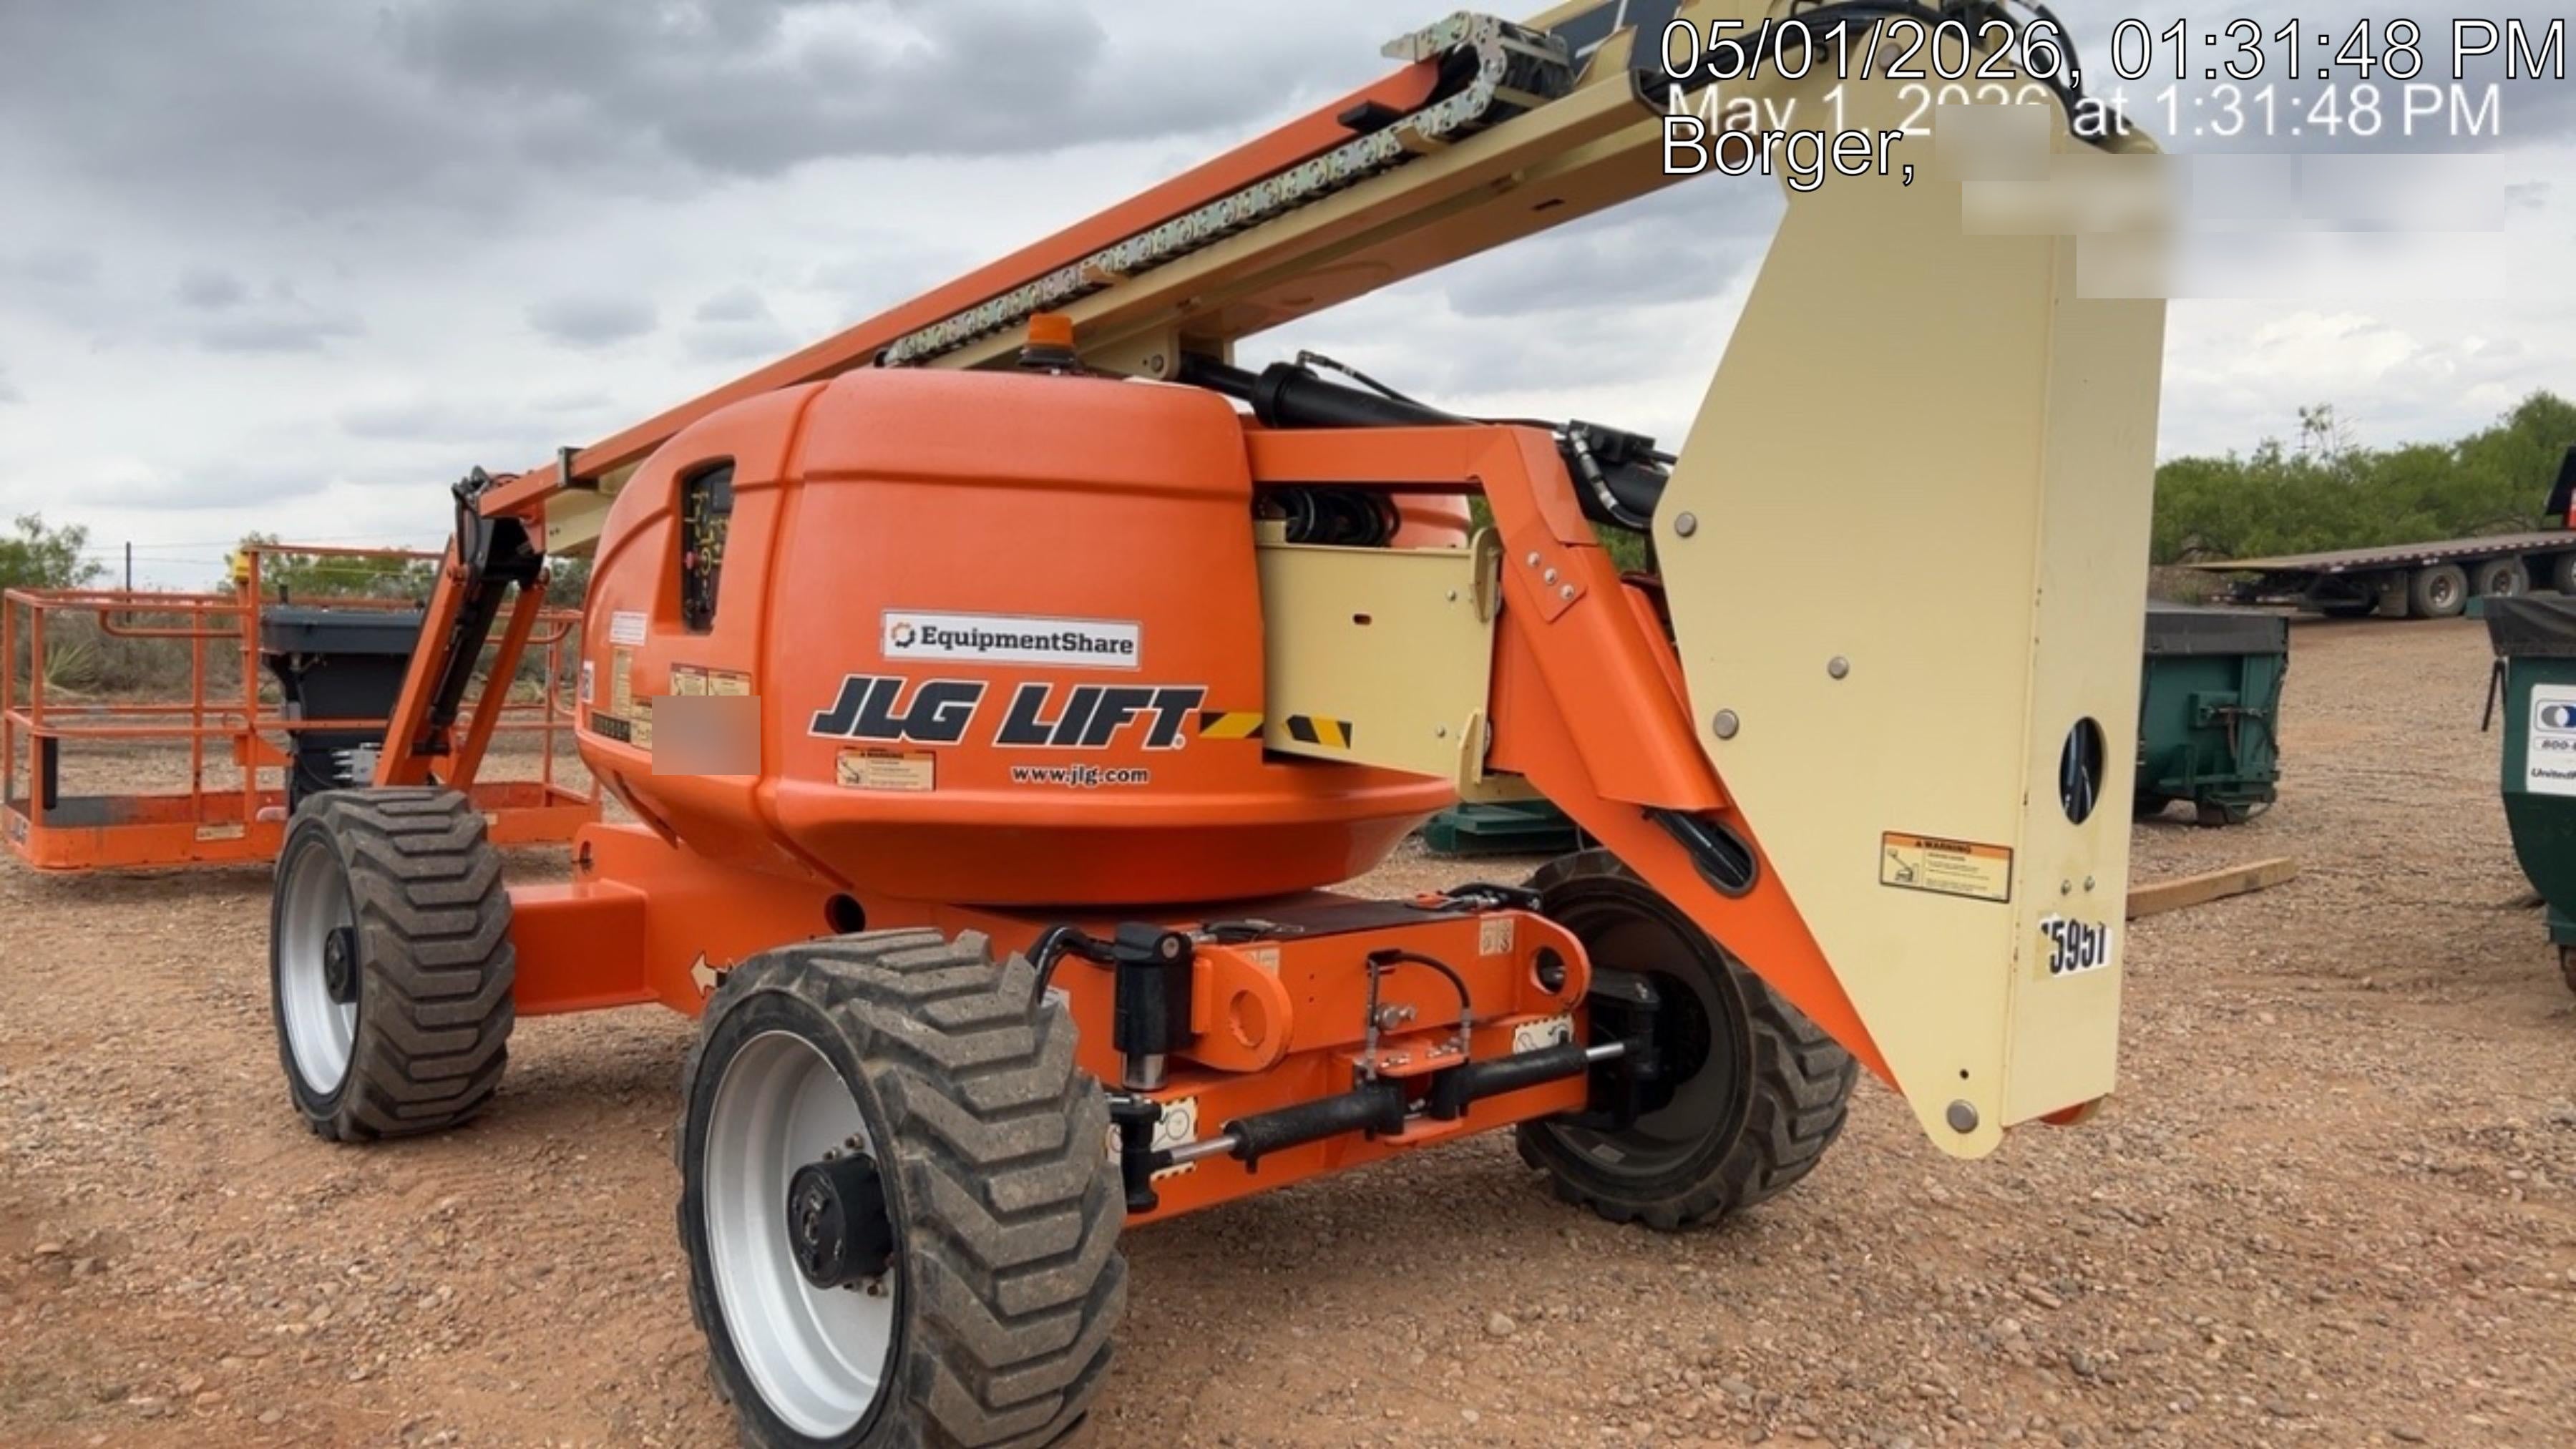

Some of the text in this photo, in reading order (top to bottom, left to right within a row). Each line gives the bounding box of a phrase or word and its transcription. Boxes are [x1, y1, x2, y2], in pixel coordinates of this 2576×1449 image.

[920, 625, 1134, 655] EquipmentShare
[809, 675, 989, 746] JLG
[1011, 764, 1150, 788] www.jlg.com
